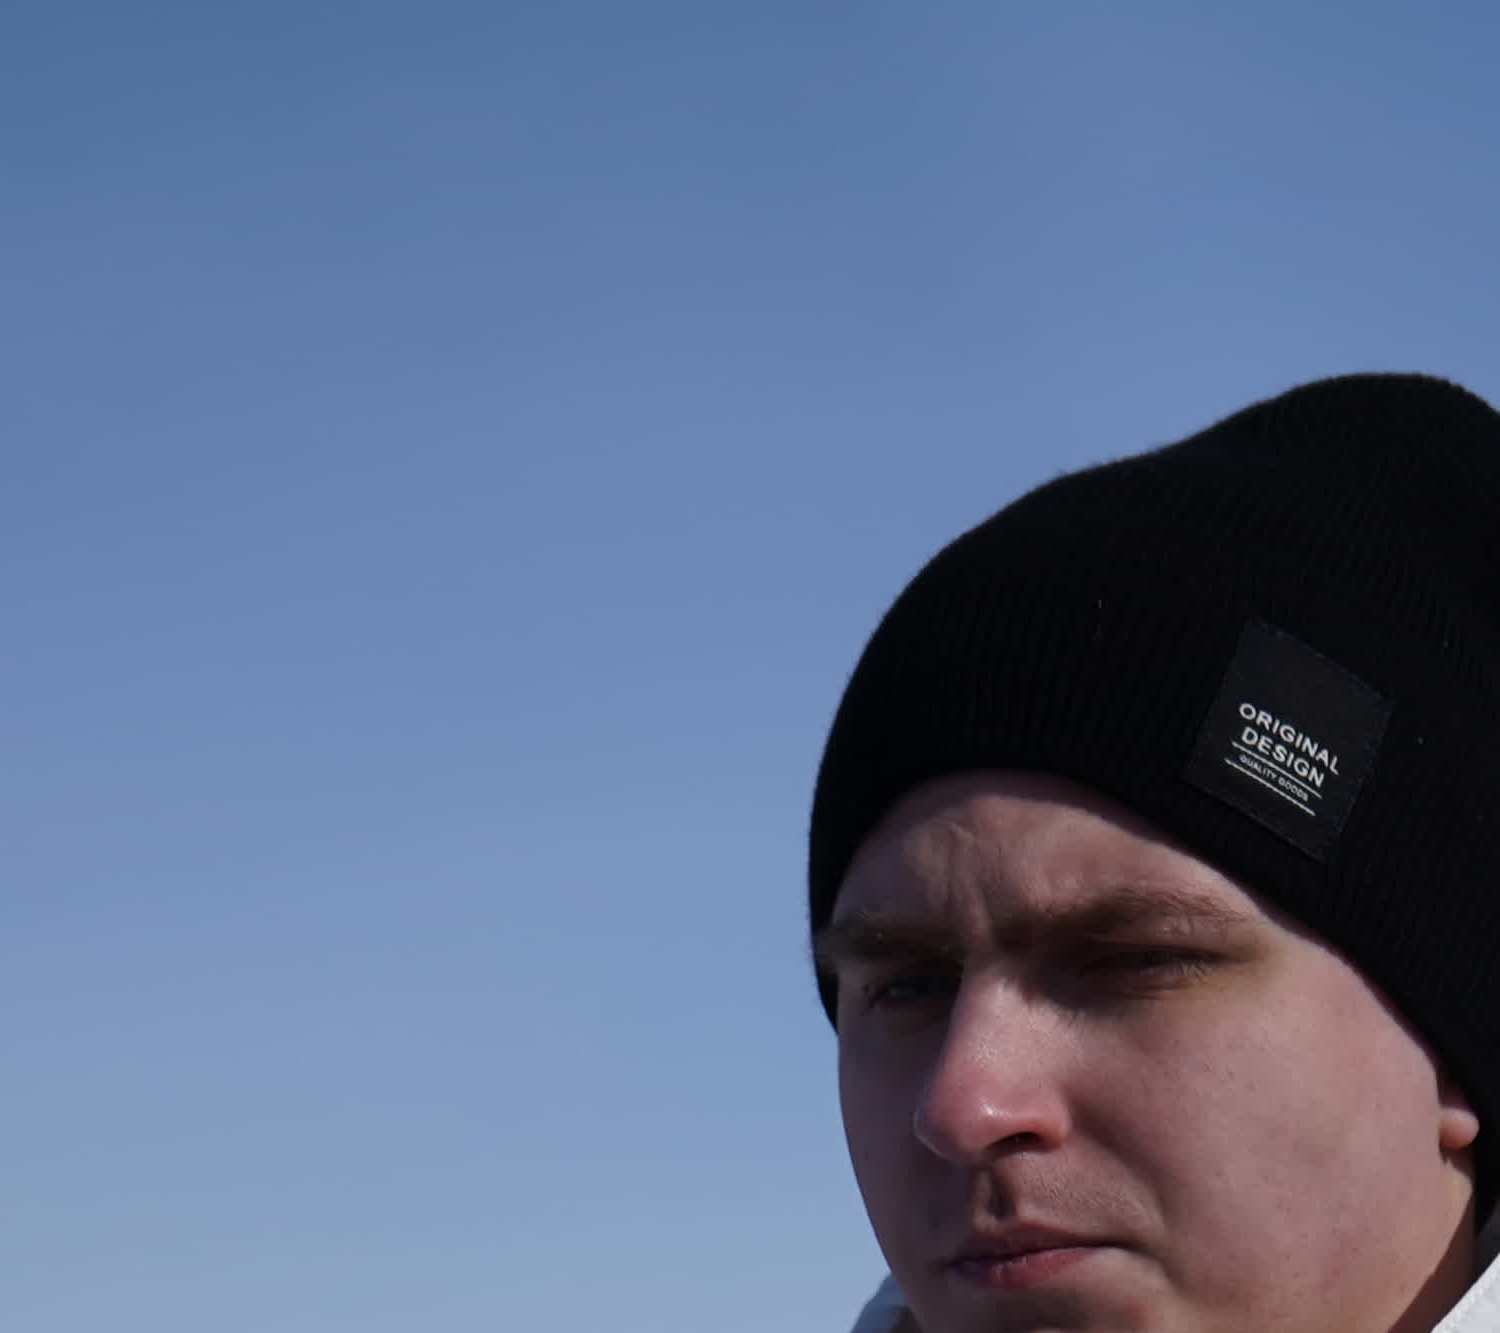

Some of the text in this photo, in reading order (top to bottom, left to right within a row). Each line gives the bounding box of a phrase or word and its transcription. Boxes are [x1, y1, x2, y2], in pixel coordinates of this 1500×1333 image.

[1239, 702, 1339, 775] ORIGINAL
[1241, 726, 1324, 788] DESIGN
[1239, 755, 1309, 801] QUALITY GOODS
